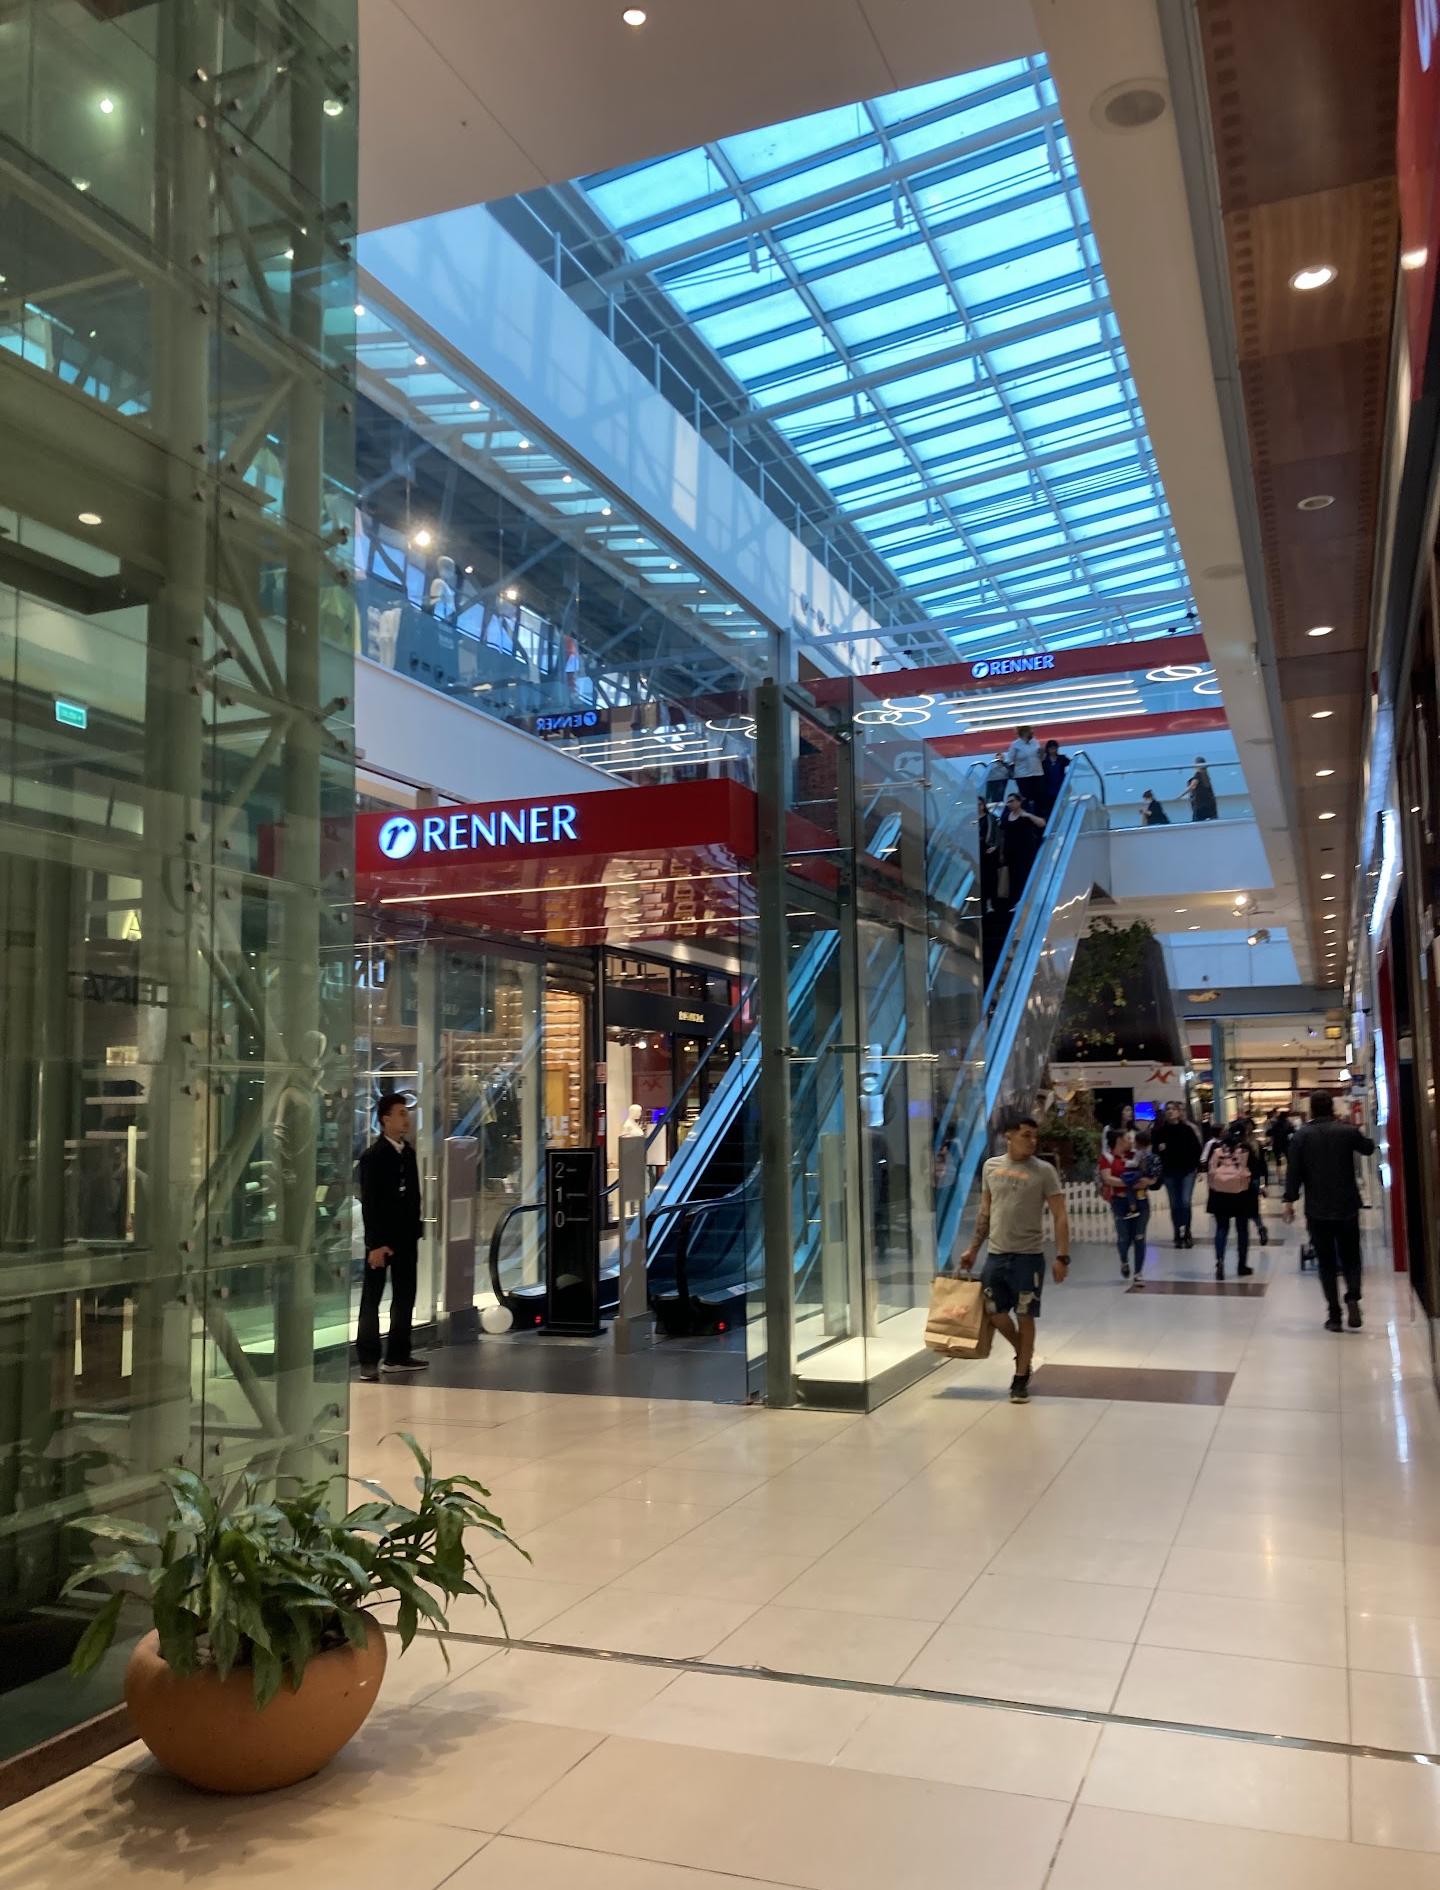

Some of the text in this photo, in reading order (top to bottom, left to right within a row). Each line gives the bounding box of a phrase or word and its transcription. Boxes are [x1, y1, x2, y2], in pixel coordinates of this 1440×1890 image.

[990, 655, 1055, 675] RENNER
[423, 804, 578, 852] RENNER
[555, 1162, 565, 1179] 2
[555, 1187, 563, 1203] 1
